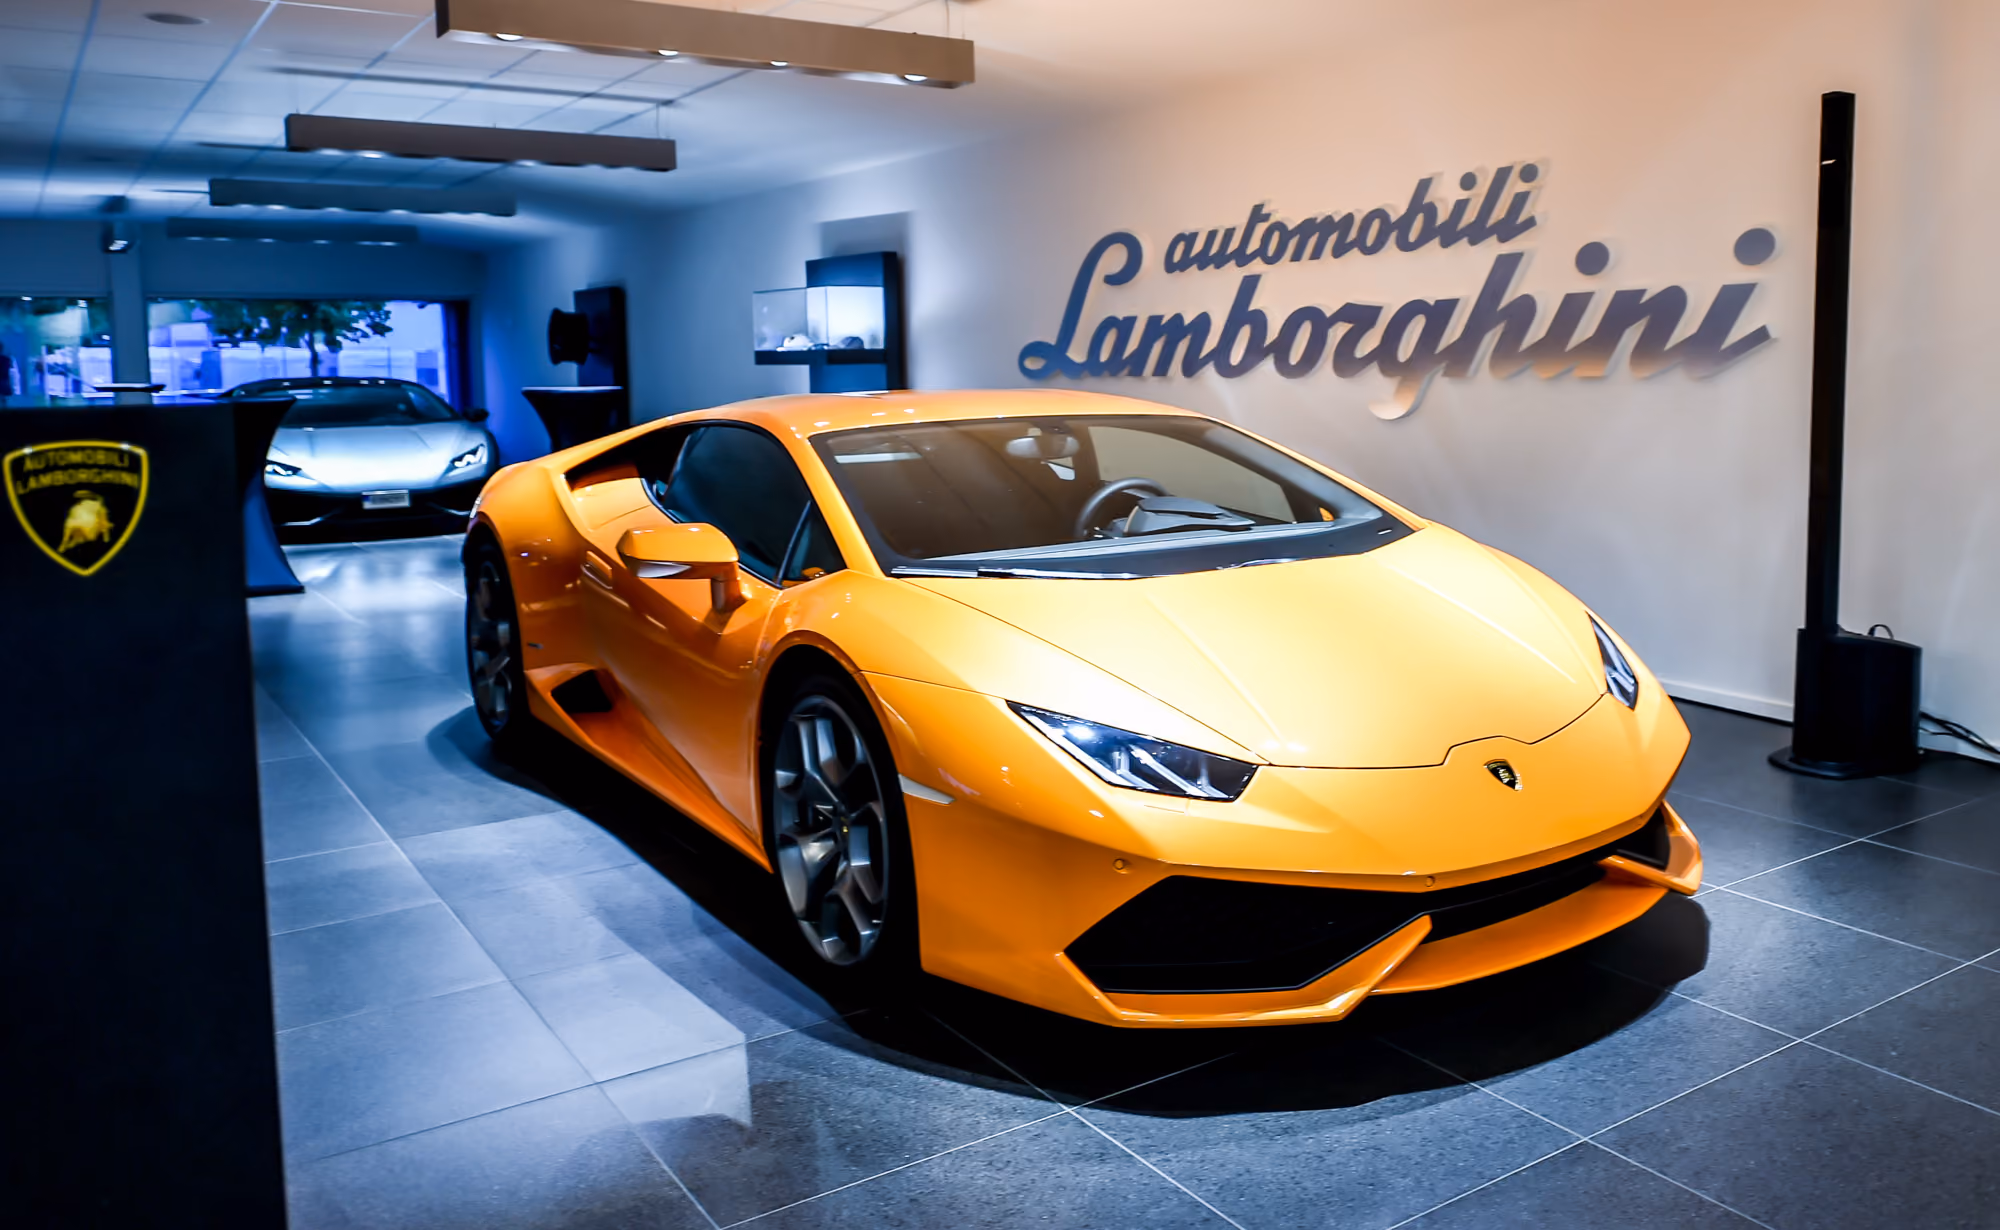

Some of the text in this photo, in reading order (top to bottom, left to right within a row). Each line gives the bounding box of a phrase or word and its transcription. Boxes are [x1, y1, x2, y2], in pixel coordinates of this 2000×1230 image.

[1164, 163, 1538, 273] automobili
[1017, 228, 1776, 419] Lamborghini
[16, 468, 139, 495] LAMBORGHINI
[24, 449, 129, 471] AUTOMOBILI
